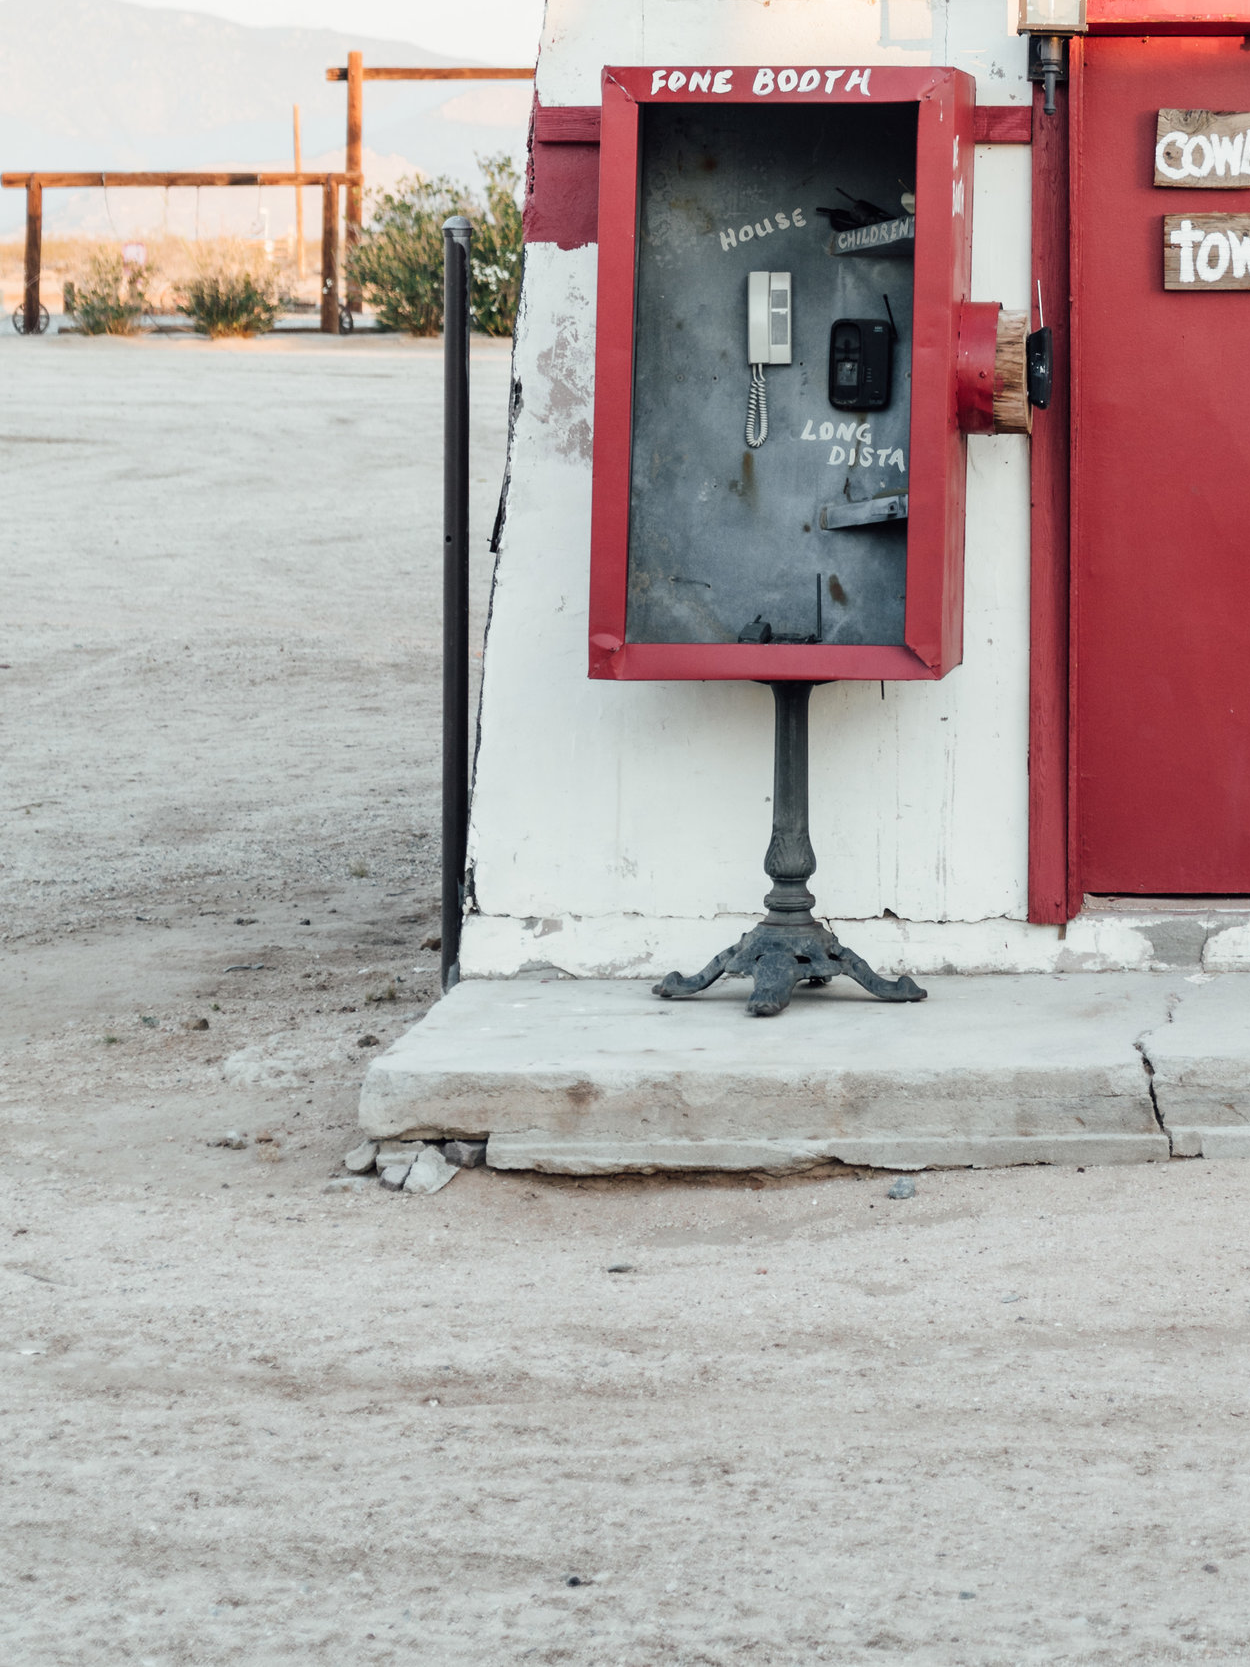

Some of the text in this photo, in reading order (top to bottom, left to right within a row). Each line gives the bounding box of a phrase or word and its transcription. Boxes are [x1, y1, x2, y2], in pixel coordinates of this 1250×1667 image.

[651, 68, 872, 96] FONE BOOTH
[719, 207, 807, 251] HOUSE
[801, 420, 872, 445] LONG
[827, 446, 905, 473] DISTA
